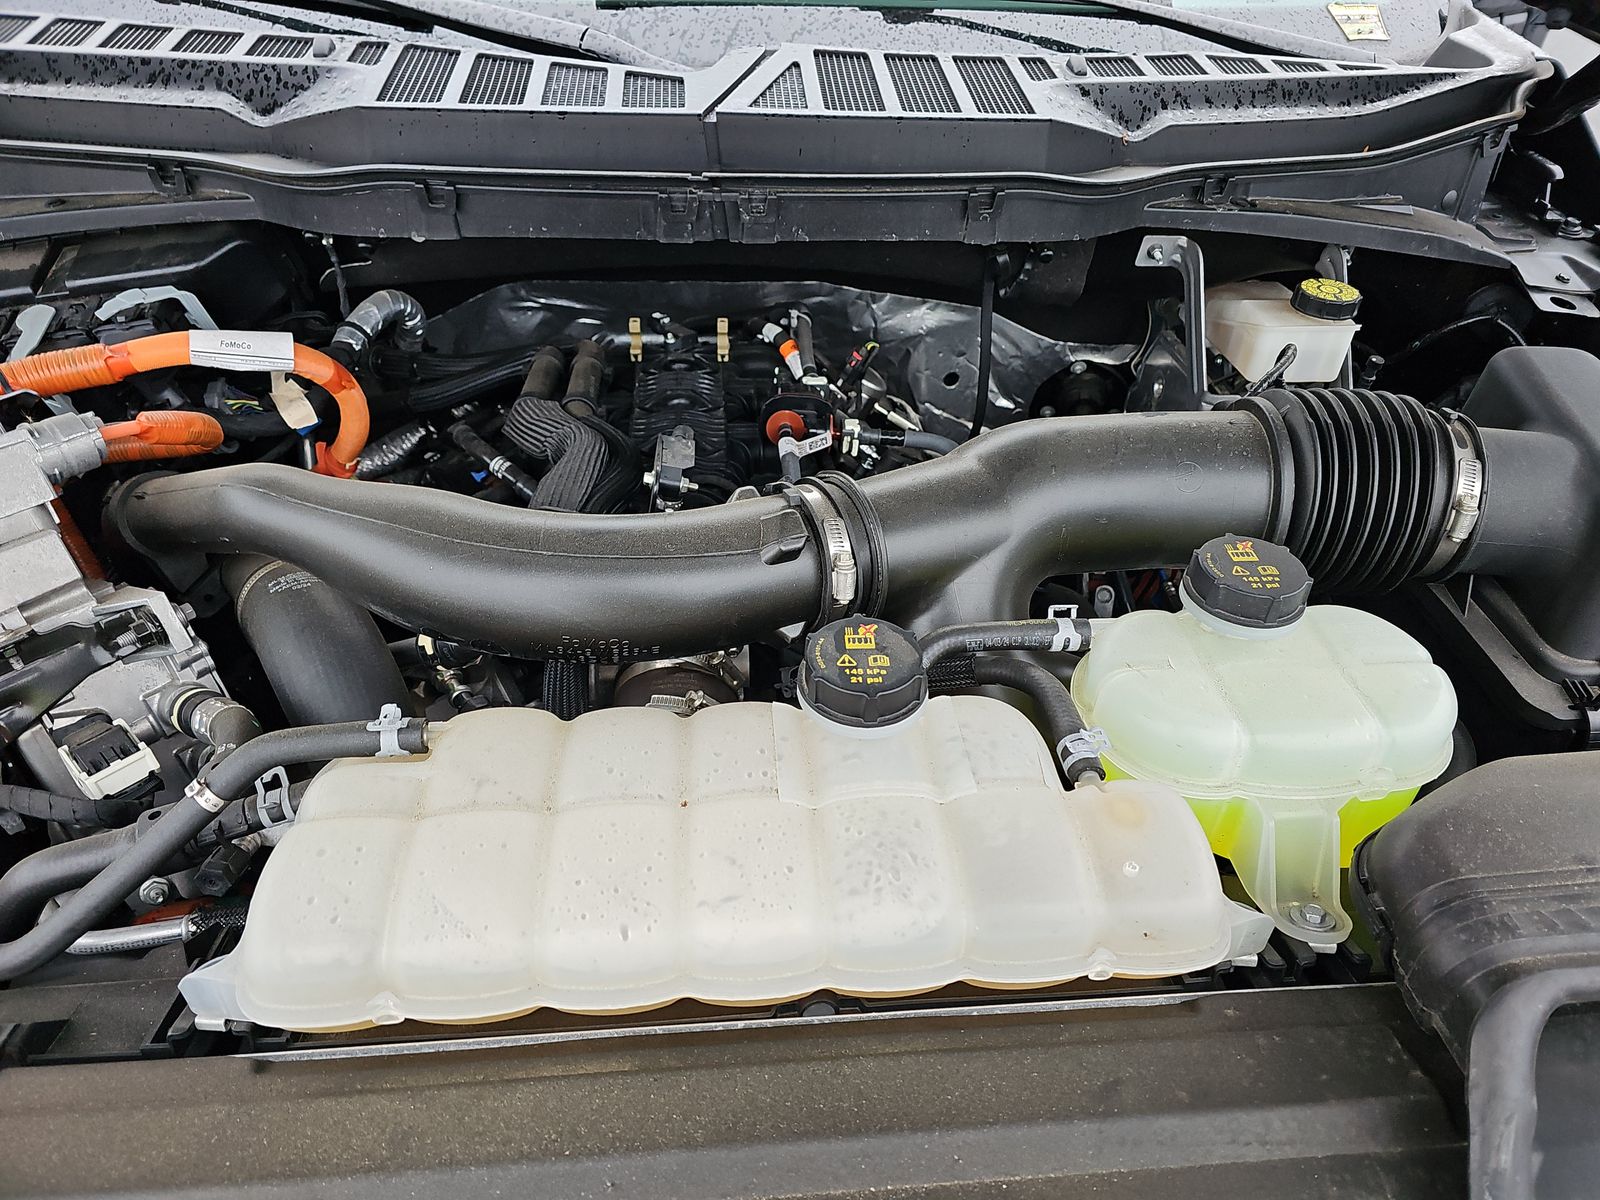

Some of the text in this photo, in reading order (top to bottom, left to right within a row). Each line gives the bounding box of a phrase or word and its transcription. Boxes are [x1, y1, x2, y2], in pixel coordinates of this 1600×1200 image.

[219, 340, 252, 350] FoMoCo
[1265, 582, 1280, 590] psi
[866, 667, 888, 676] kPa
[849, 675, 884, 685] 21 psi
